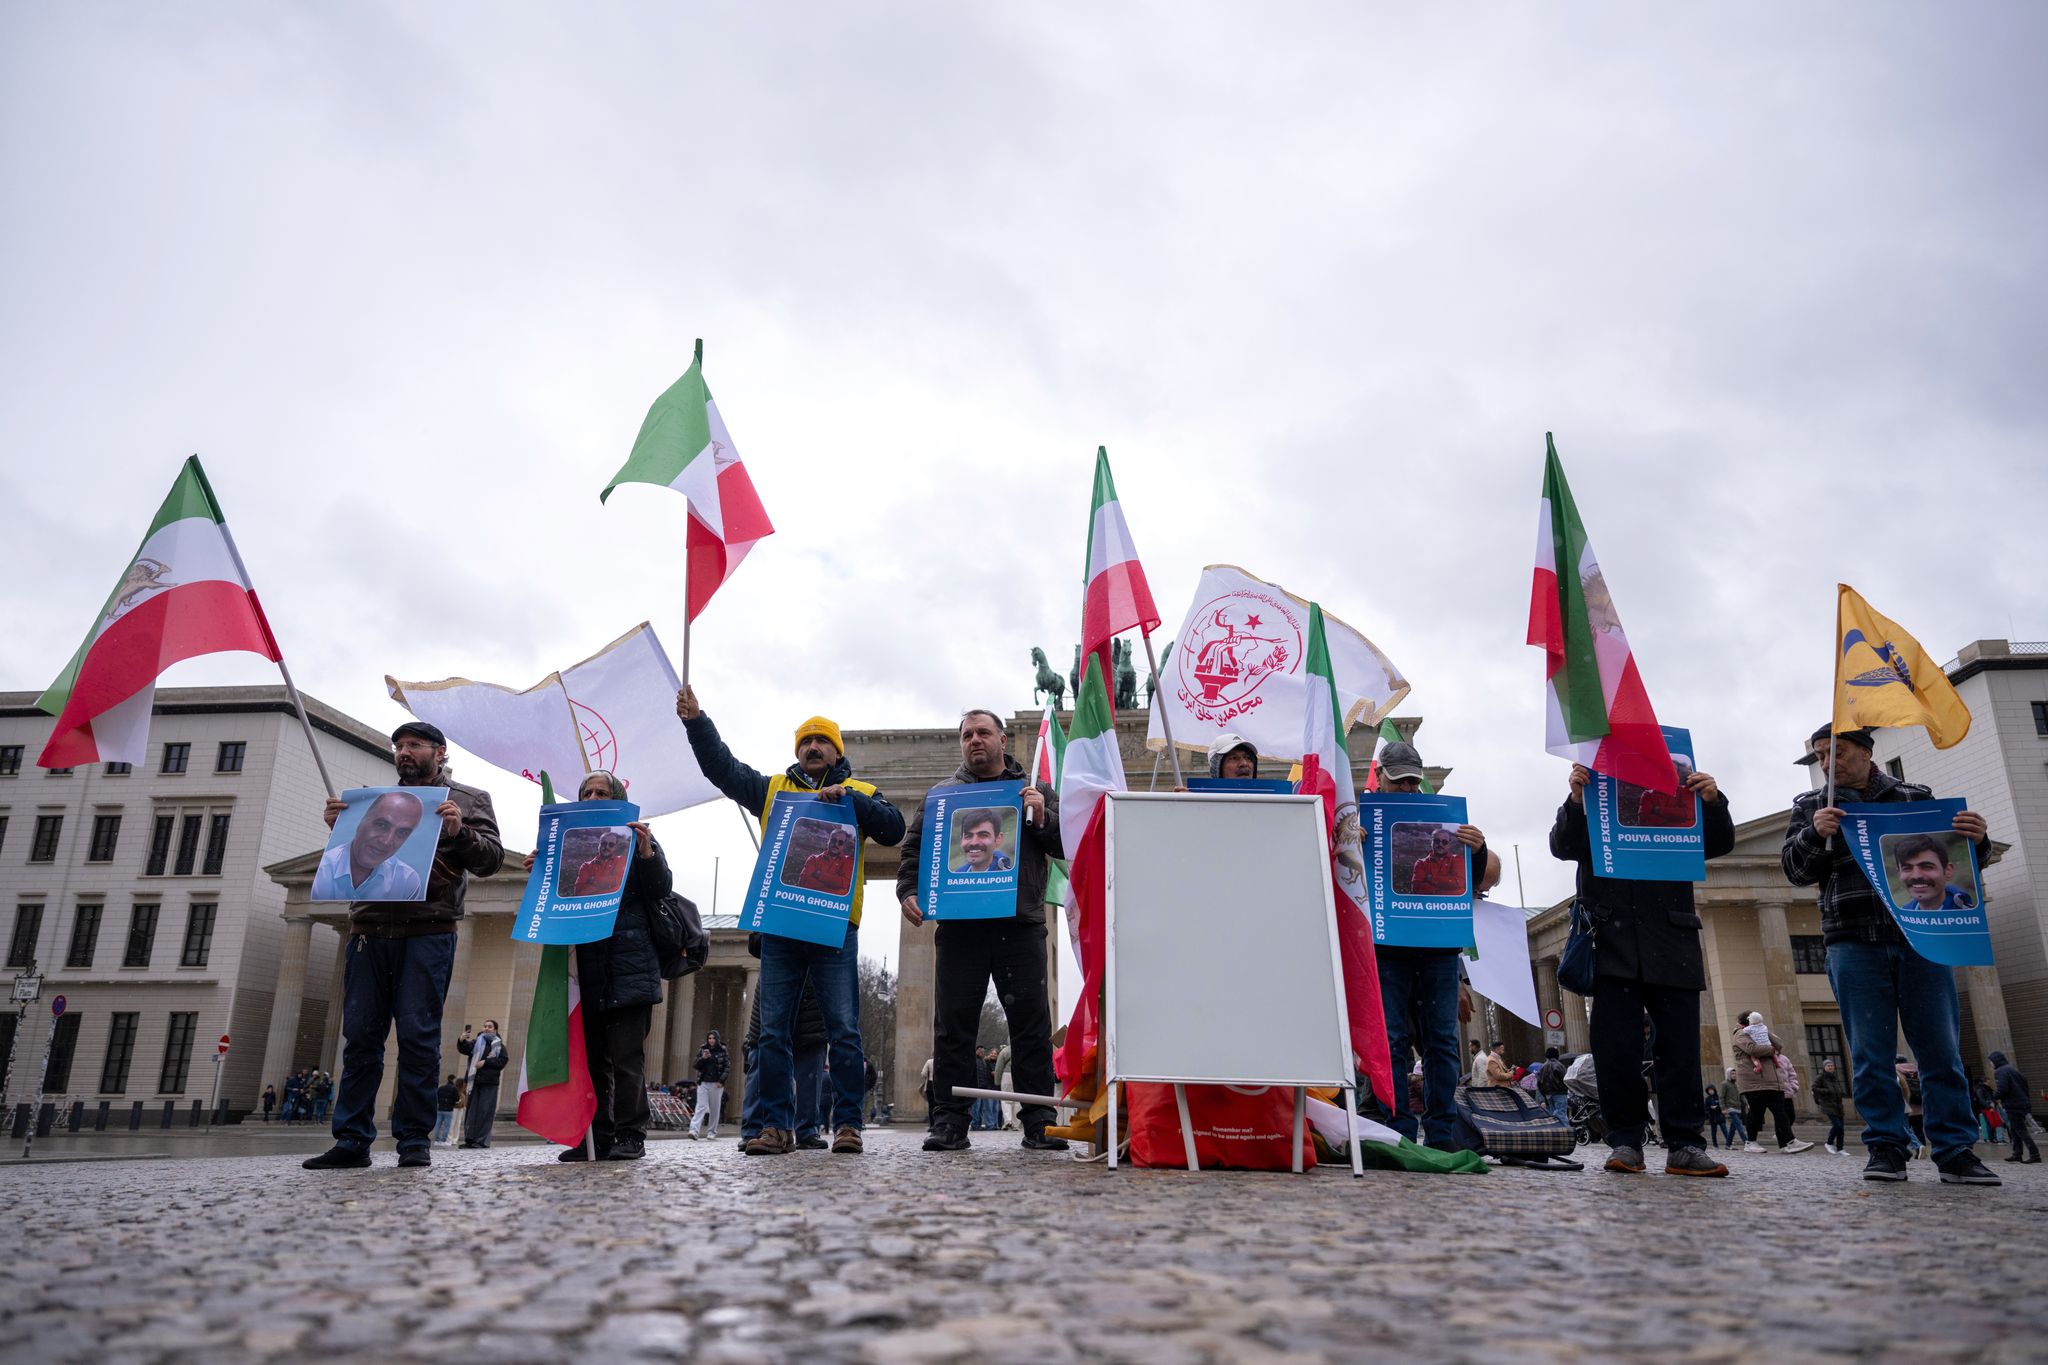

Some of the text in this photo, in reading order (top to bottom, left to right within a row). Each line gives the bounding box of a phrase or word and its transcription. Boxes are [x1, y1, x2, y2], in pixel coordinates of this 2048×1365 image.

[1597, 781, 1611, 843] EXECUTION
[1618, 834, 1701, 844] POUYA GHOBADI
[1857, 820, 1870, 846] IRAN
[752, 805, 794, 927] STOP EXECUTION IN IRAN
[928, 799, 946, 916] STOP EXECUTION IN IRAN
[1602, 844, 1614, 873] STOP
[1862, 849, 1873, 861] IN
[527, 818, 560, 939] STOP EXECUTION IN IRAN
[947, 876, 1013, 886] BABAK ALIPOUR
[1373, 808, 1385, 940] STOP EXECUTION IN IRAN
[552, 897, 620, 912] POUYA GHOBADI
[775, 890, 849, 912] POUYA GHOBADI
[1391, 901, 1471, 911] POUYA GHOBADI
[1900, 914, 1980, 926] BABAK ALIPOUR
